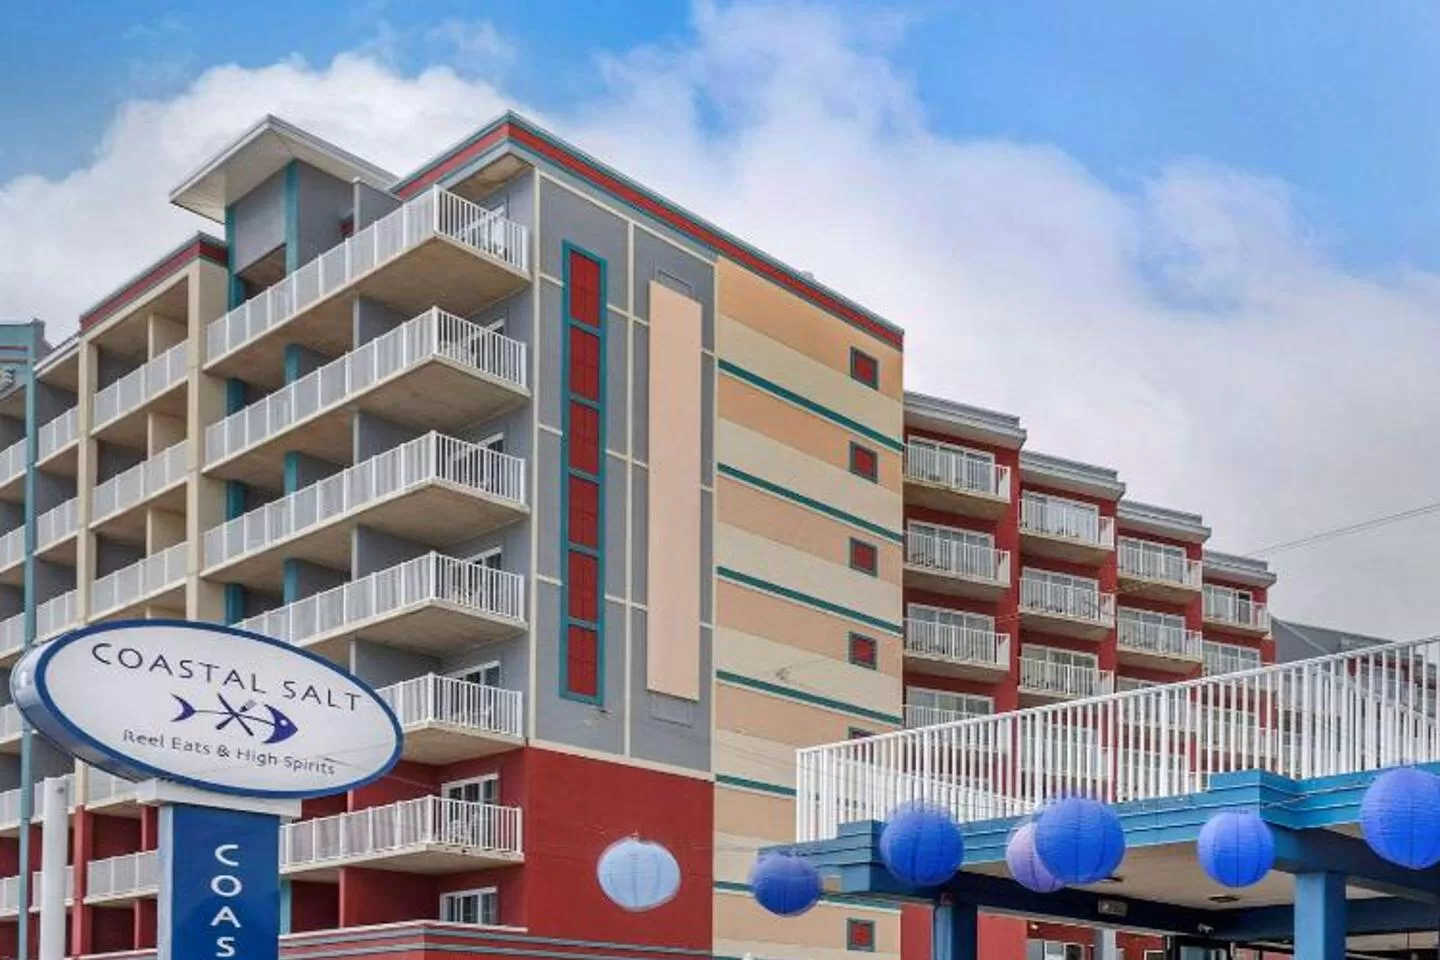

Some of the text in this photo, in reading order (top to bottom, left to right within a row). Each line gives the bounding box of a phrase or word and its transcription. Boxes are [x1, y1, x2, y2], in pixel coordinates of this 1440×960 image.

[92, 643, 361, 711] COASTAL SALT
[123, 728, 335, 775] Reel Eats & High Spirits
